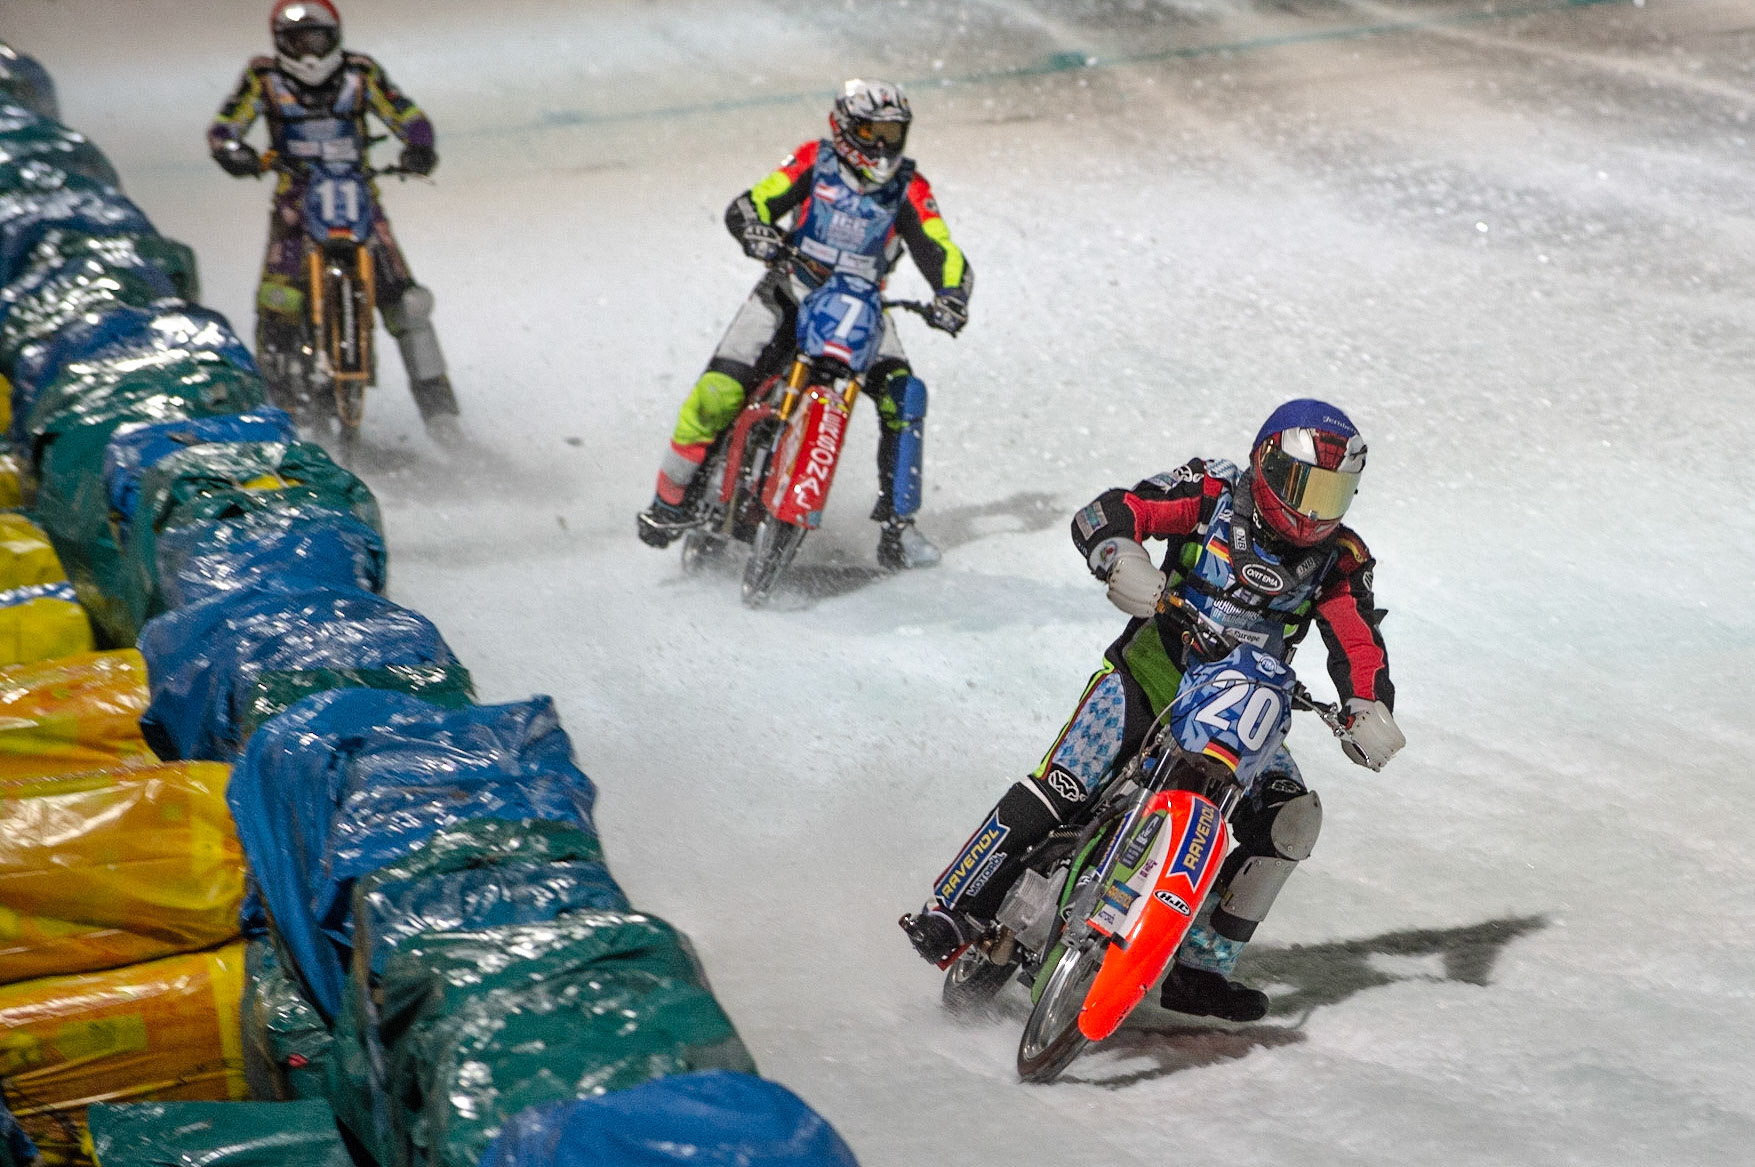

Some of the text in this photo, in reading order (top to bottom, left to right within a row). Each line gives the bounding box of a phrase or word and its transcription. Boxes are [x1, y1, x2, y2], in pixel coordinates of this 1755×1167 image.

[314, 179, 359, 222] 11
[835, 295, 863, 339] 7
[1246, 568, 1278, 588] ORTEMA
[1233, 630, 1261, 643] Europe
[1195, 669, 1281, 752] 20
[1182, 805, 1215, 870] RAVENOL
[941, 829, 1000, 899] RAVENOL
[1159, 891, 1190, 913] HJC
